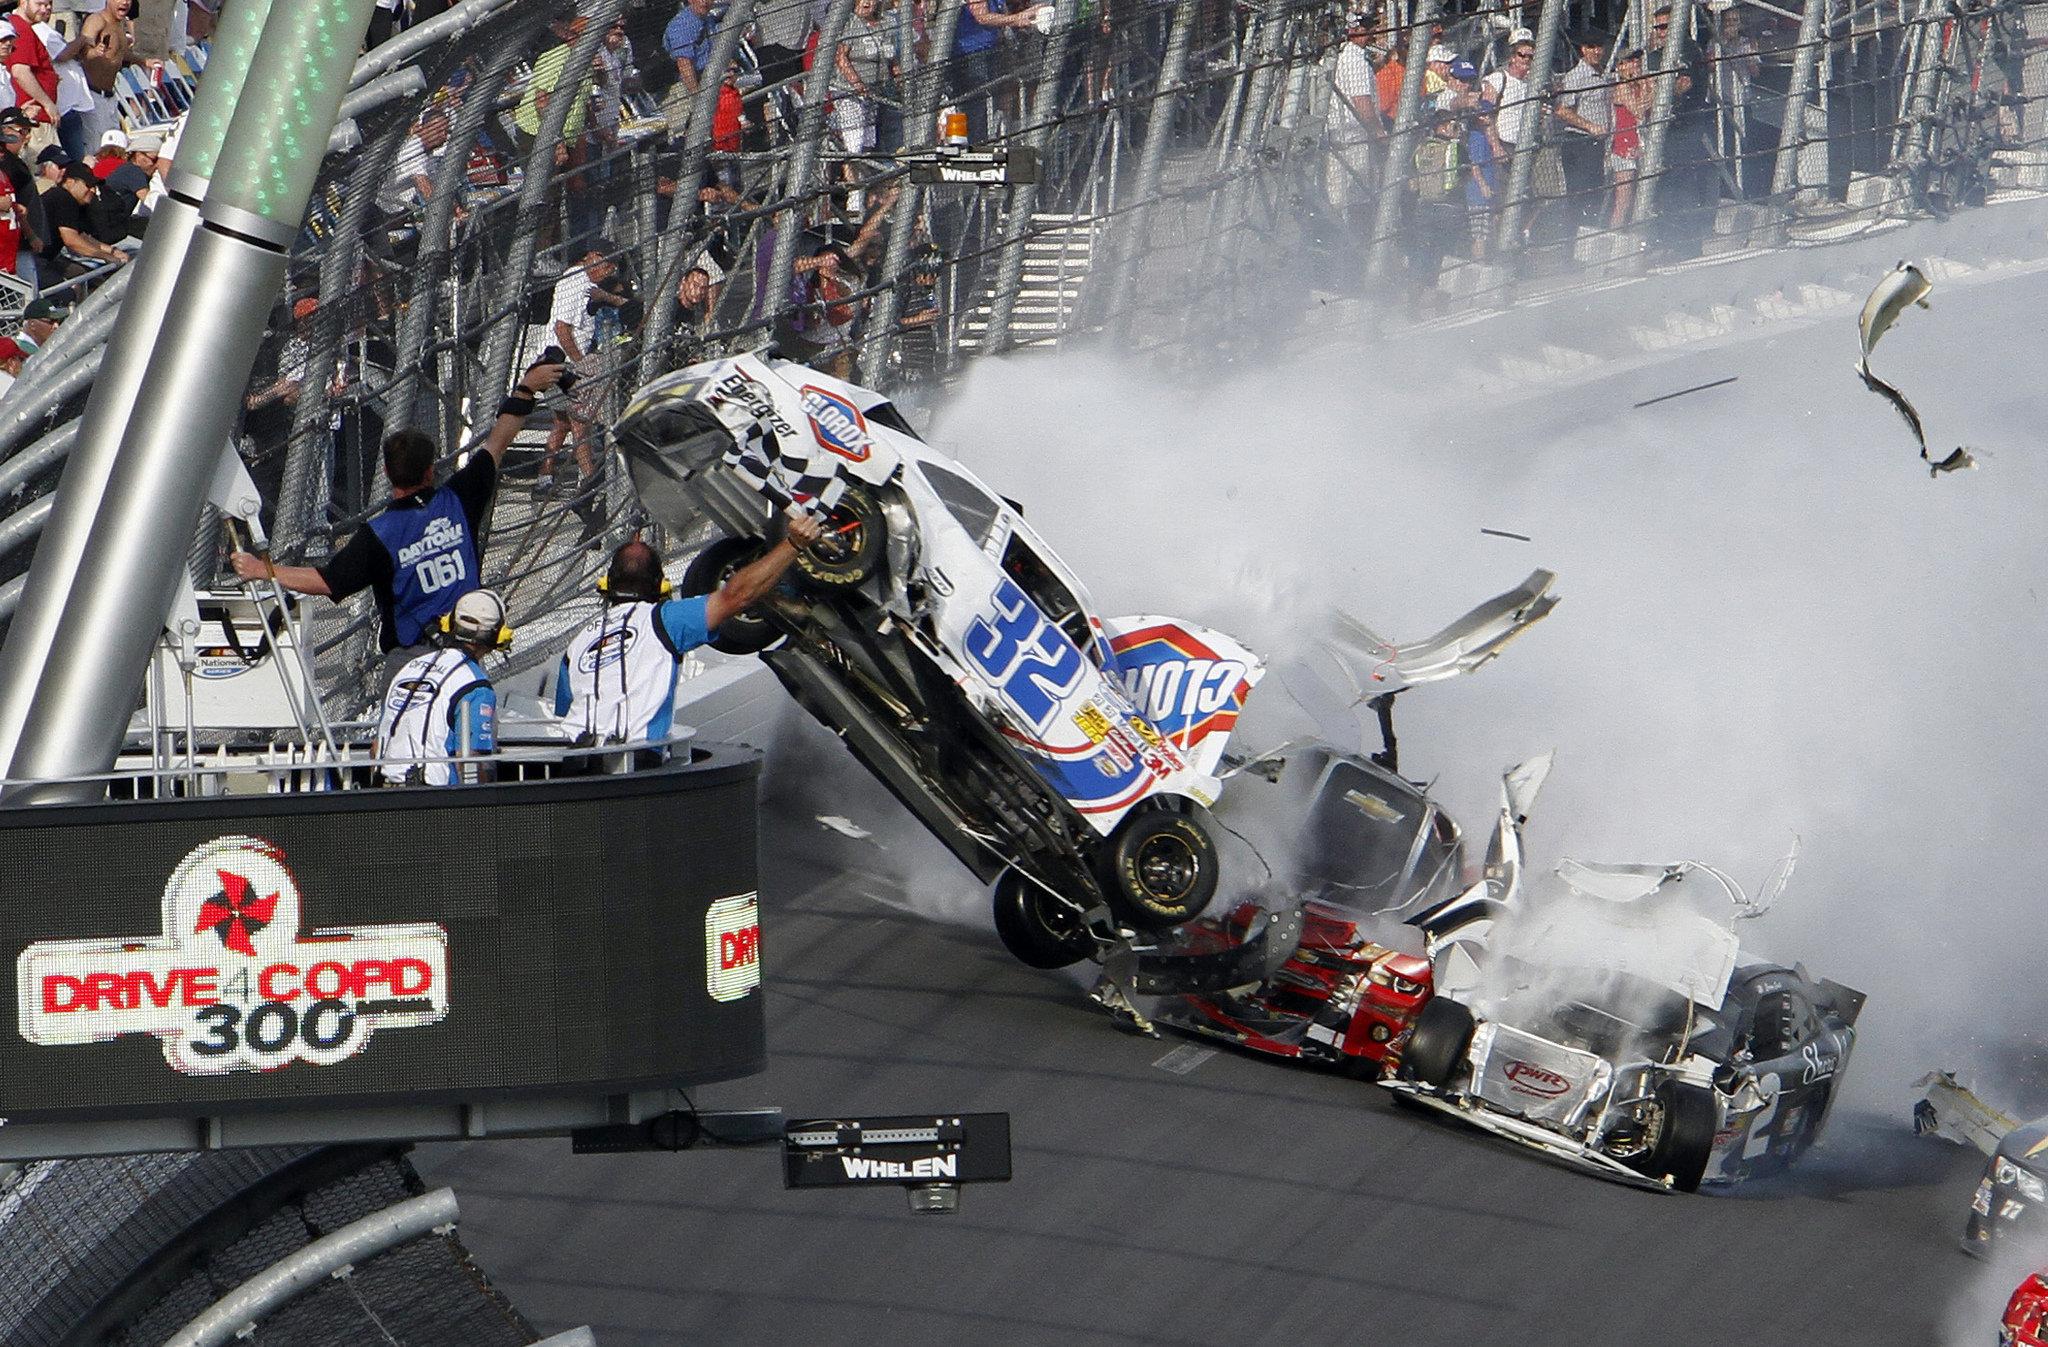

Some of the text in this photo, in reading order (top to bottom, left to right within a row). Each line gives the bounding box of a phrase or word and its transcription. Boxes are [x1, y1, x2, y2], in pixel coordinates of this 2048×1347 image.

[940, 167, 1005, 181] WHELEN
[722, 373, 799, 438] Energizer
[801, 391, 876, 455] CLOROX
[398, 523, 464, 563] DAYTONA
[416, 549, 466, 594] 061
[965, 577, 1086, 735] 32
[1145, 755, 1172, 780] 3M
[190, 999, 350, 1056] 300
[841, 1154, 957, 1178] WHELEN
